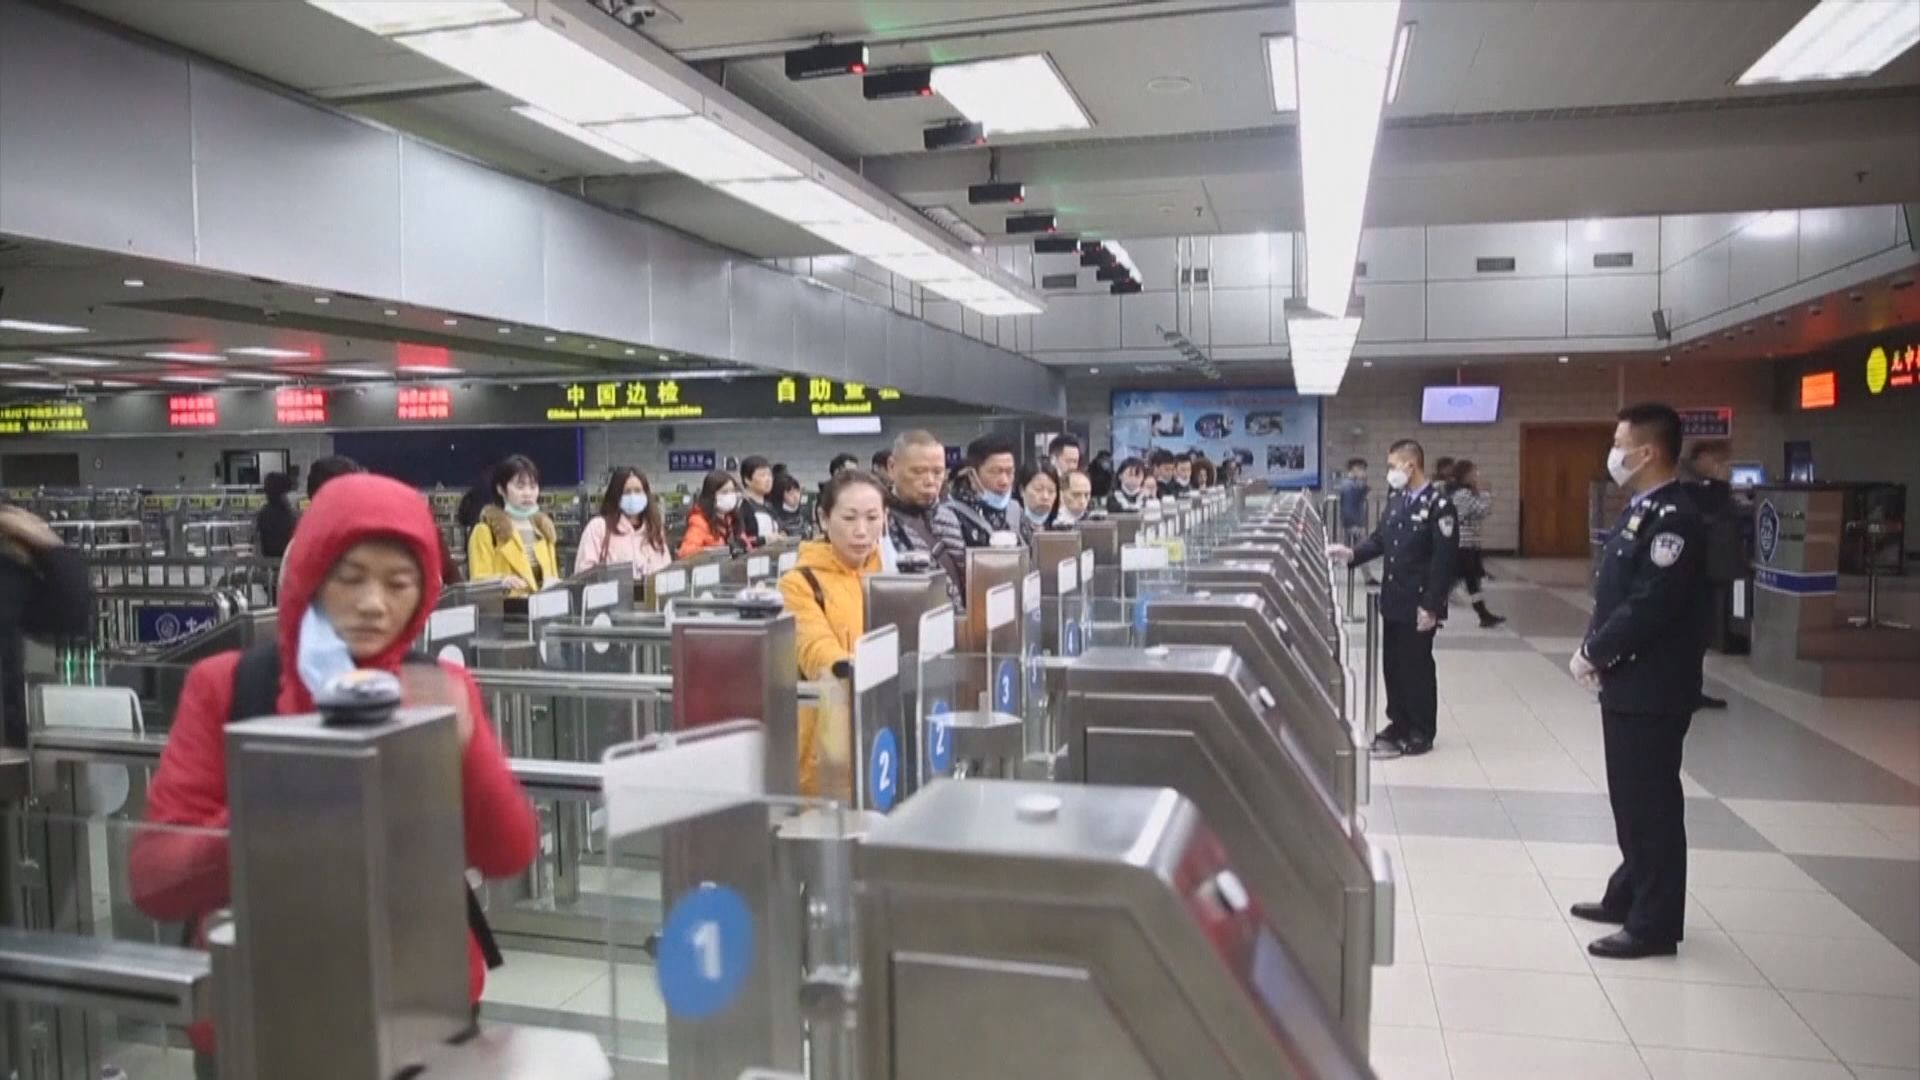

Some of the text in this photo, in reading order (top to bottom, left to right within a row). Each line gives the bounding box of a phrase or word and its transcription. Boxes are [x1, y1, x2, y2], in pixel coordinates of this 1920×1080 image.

[567, 380, 679, 406] 中国边检
[579, 406, 642, 421] Immigration
[644, 404, 702, 419] Inspection
[1002, 675, 1010, 704] 3
[936, 718, 945, 755] 2
[879, 750, 891, 791] 2
[692, 920, 721, 979] 1
